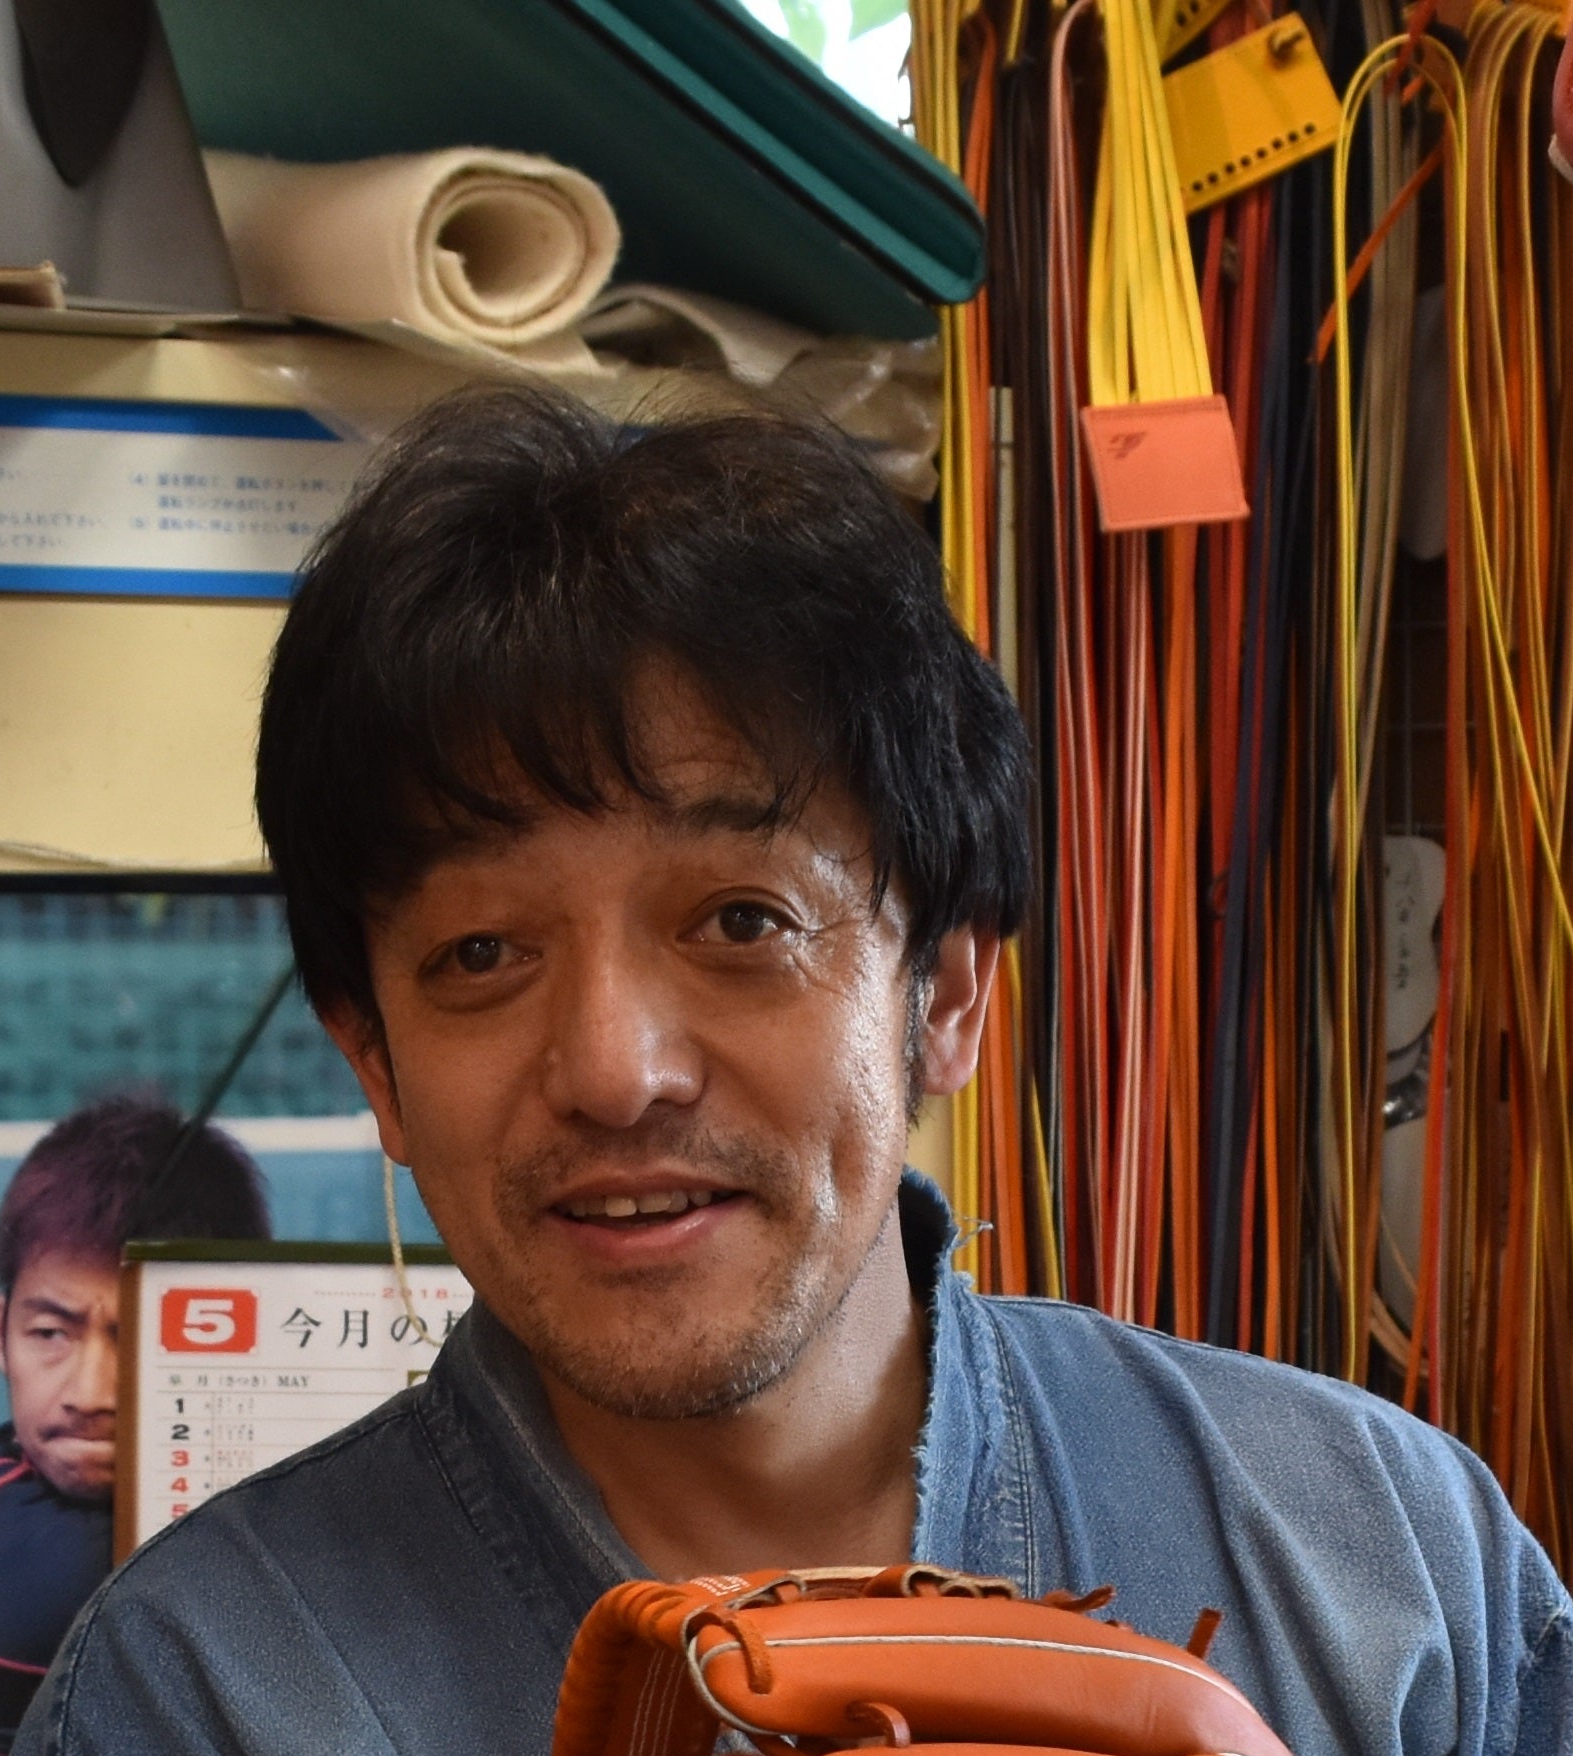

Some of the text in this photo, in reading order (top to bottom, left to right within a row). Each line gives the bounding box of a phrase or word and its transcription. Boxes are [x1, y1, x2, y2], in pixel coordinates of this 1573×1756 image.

[182, 1299, 236, 1345] 5
[278, 1375, 310, 1388] MAY
[174, 1398, 185, 1414] 1
[171, 1424, 190, 1440] 2
[171, 1450, 189, 1467] 3
[171, 1476, 189, 1493] 4
[172, 1503, 188, 1518] 5
